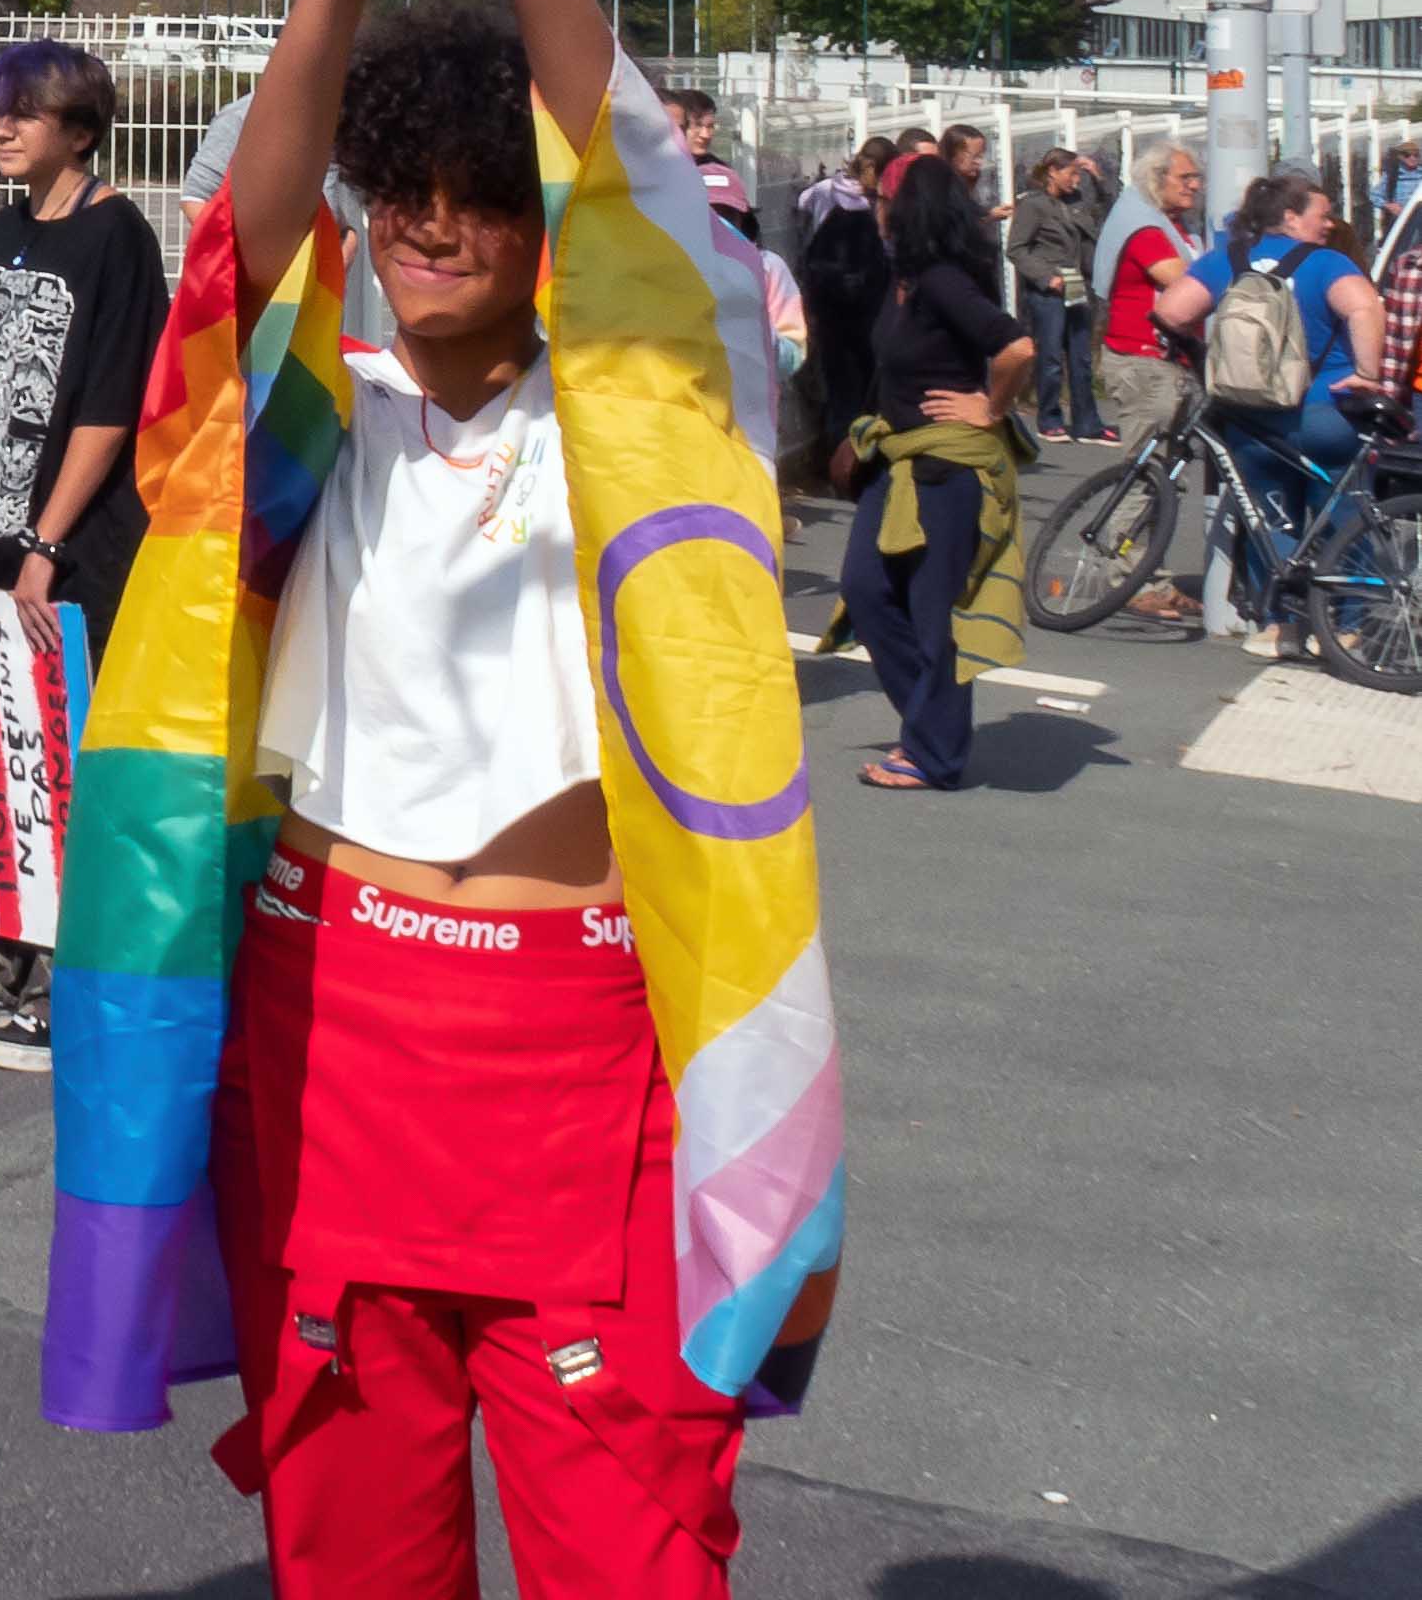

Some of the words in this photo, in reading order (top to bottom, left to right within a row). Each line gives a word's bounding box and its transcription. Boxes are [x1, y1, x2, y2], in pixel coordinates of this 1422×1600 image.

[23, 728, 55, 827] PAS
[14, 807, 36, 877] NE
[350, 884, 521, 951] Supreme
